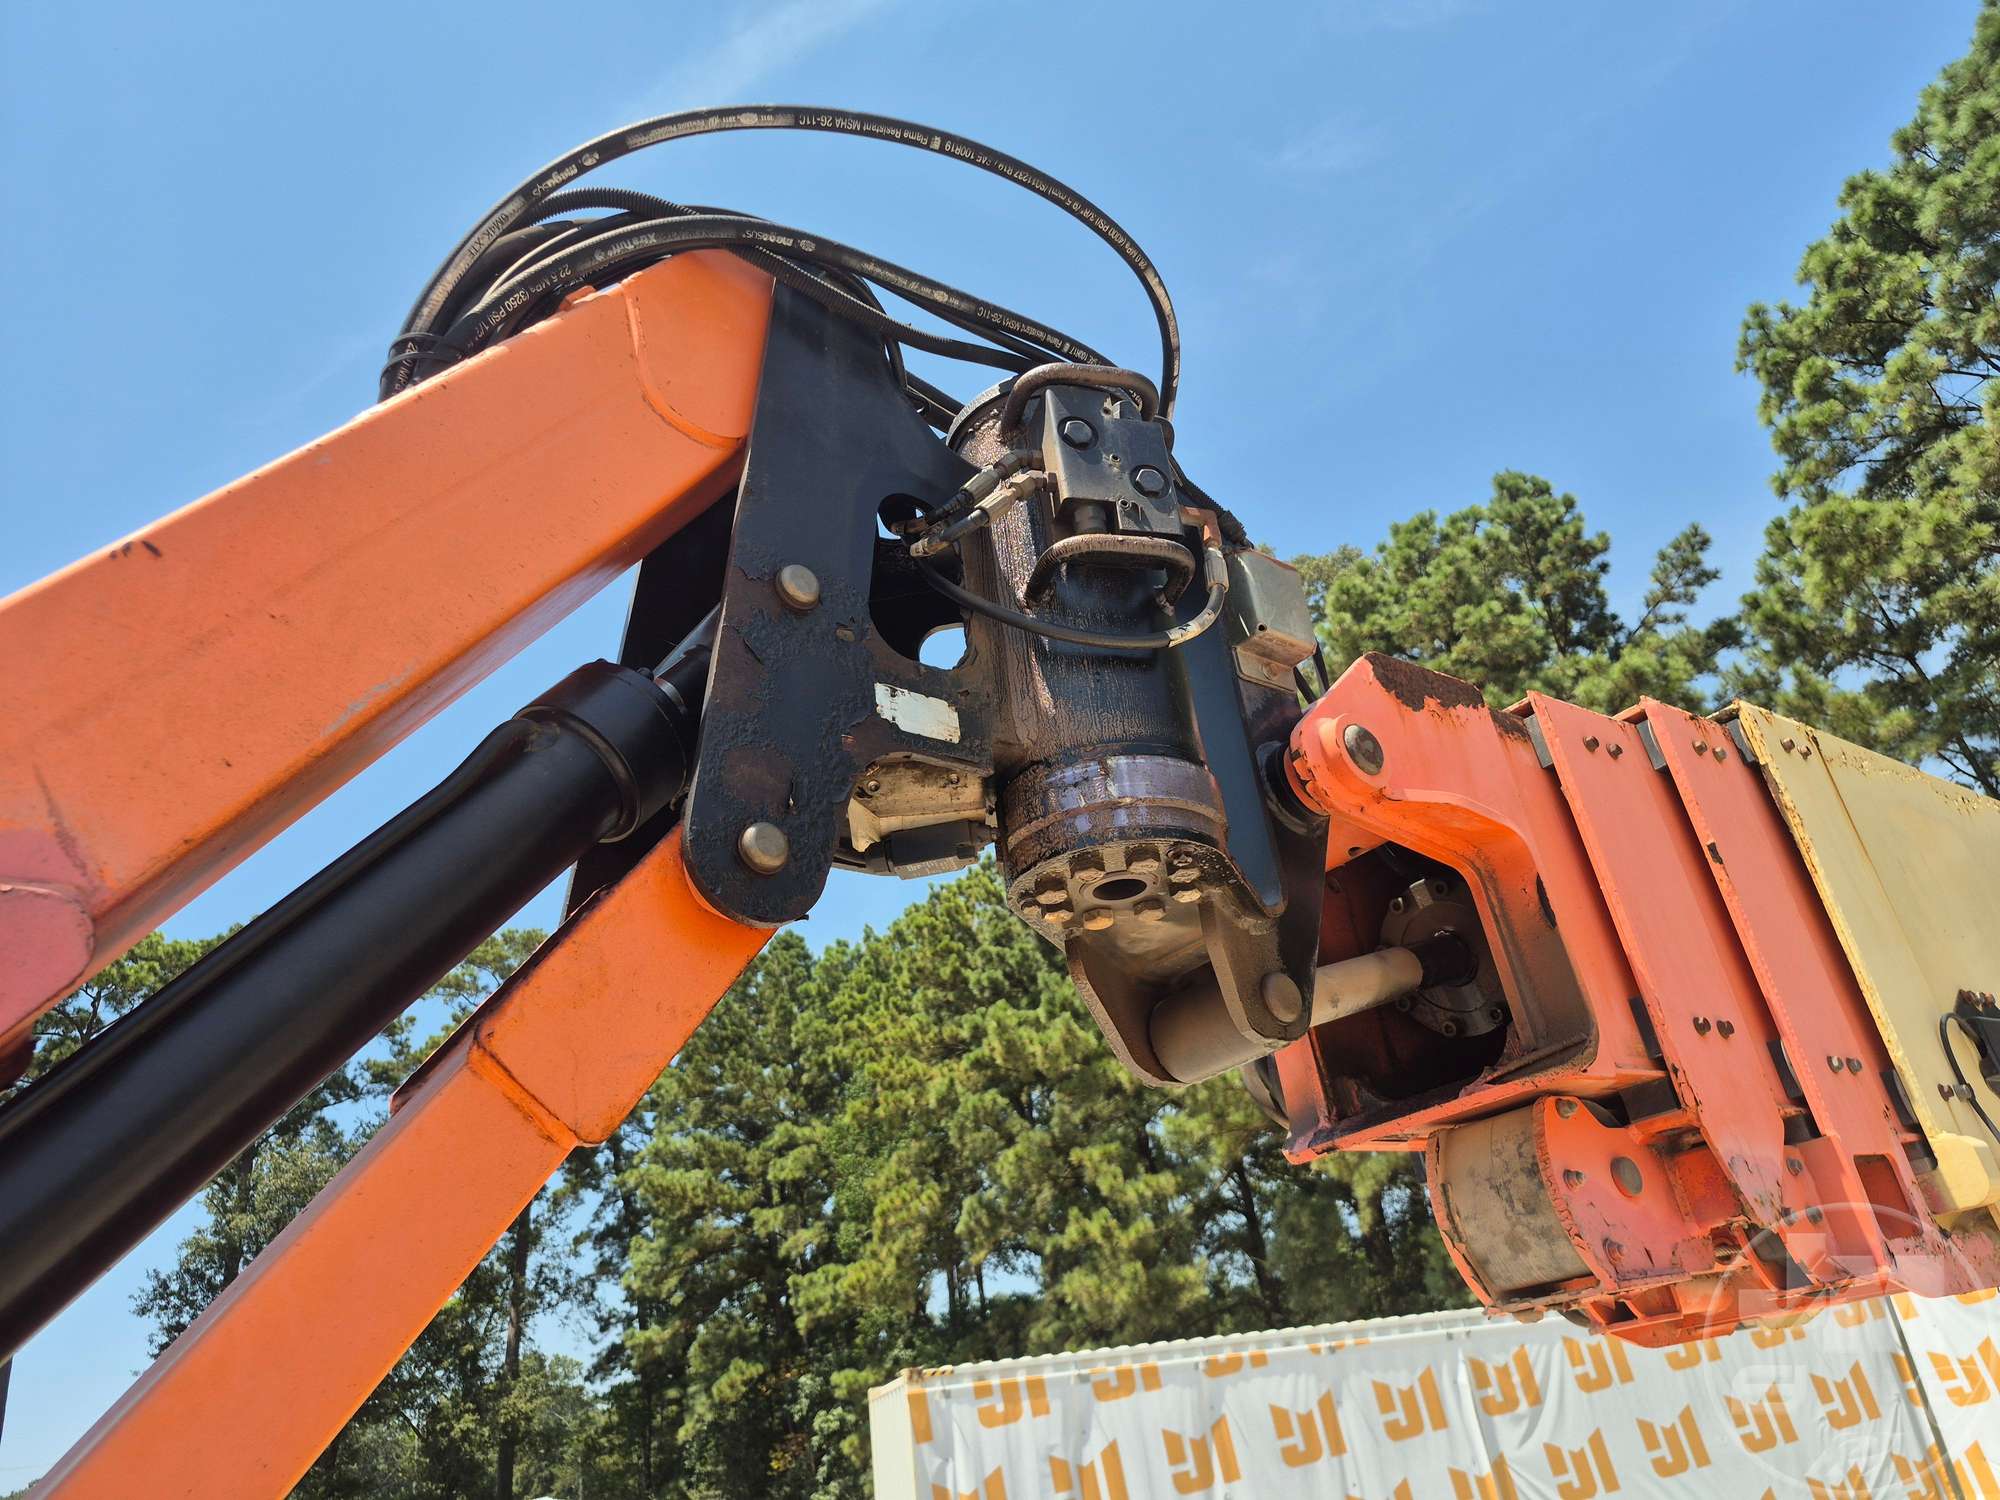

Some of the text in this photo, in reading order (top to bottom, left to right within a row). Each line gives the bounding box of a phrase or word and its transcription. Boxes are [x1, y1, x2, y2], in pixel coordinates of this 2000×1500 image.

[798, 113, 833, 128] 2G-11C
[833, 116, 861, 130] MSHA
[861, 120, 901, 139] Resistant
[902, 128, 929, 145] Flame
[943, 139, 977, 159] 100R19
[502, 286, 532, 313] (3250
[485, 304, 508, 326] PSI)
